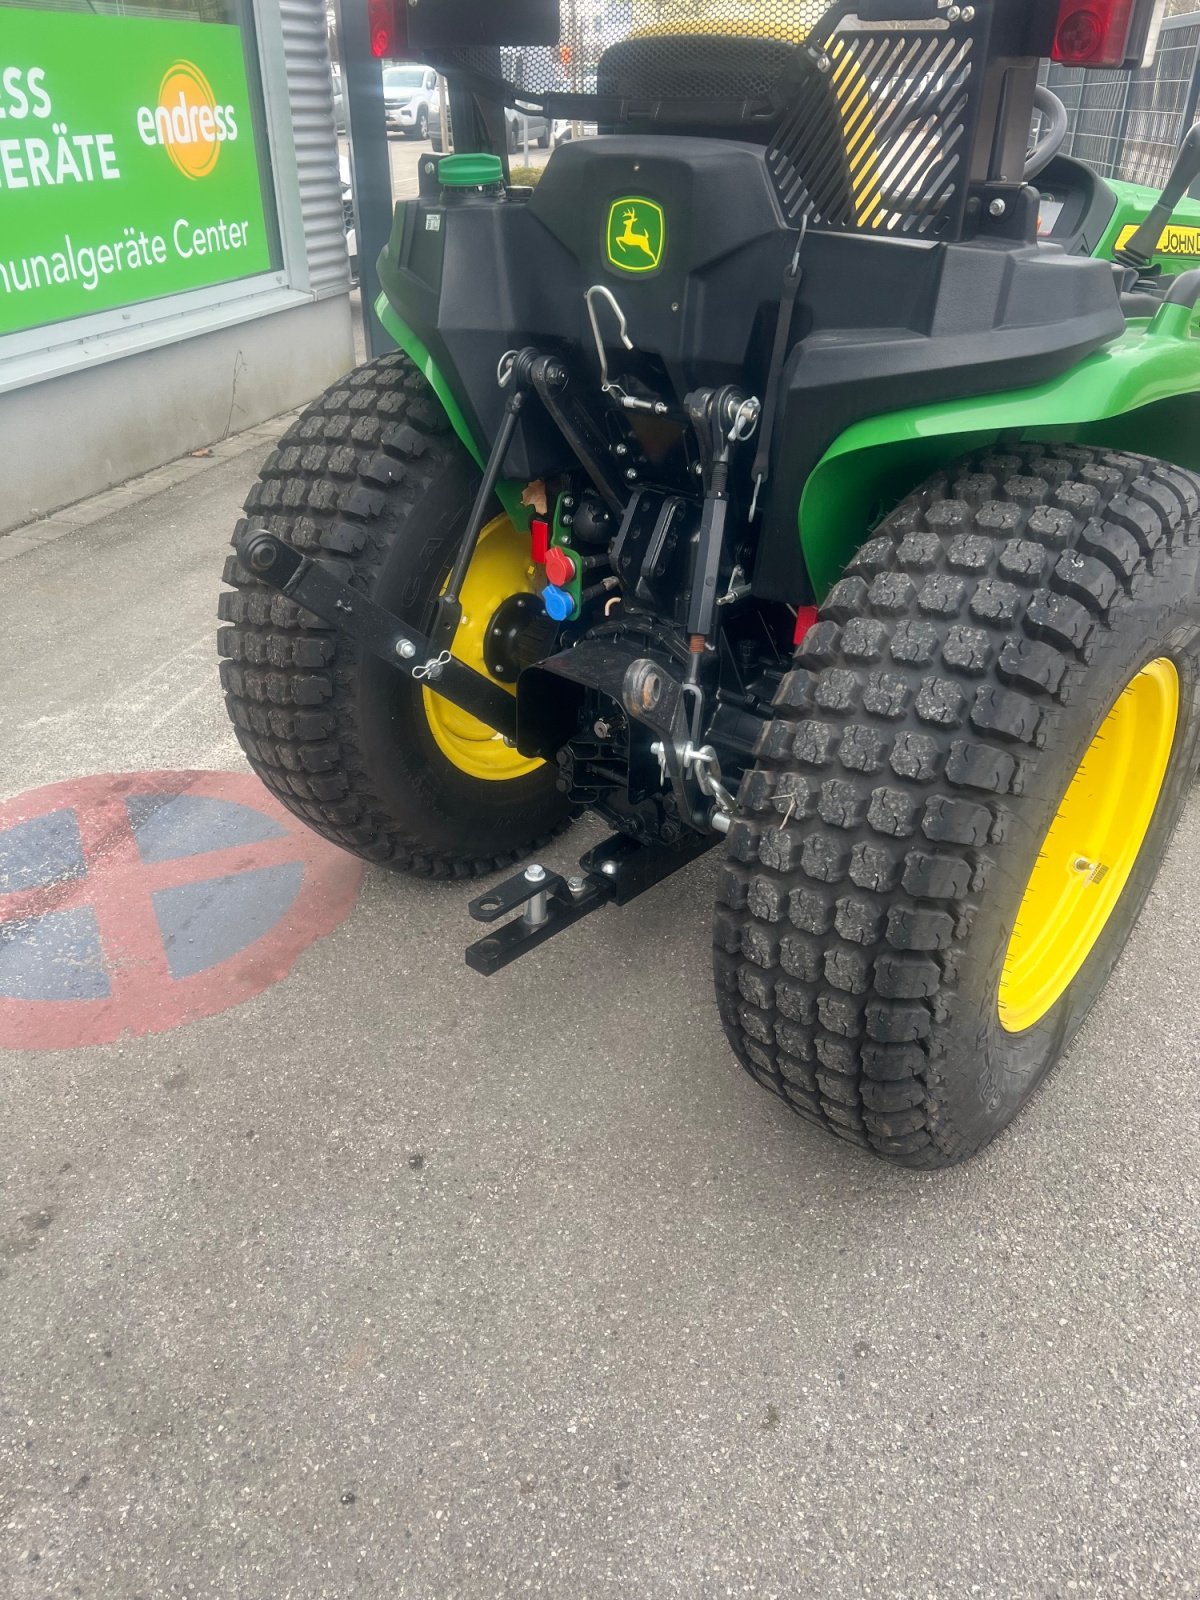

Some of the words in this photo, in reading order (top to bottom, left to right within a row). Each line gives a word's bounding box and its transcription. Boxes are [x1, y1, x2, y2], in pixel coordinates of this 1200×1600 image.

[0, 66, 52, 119] SS
[137, 91, 238, 145] endress
[0, 122, 121, 189] ERÄTE
[173, 218, 249, 259] Center
[1163, 229, 1195, 251] JOHN
